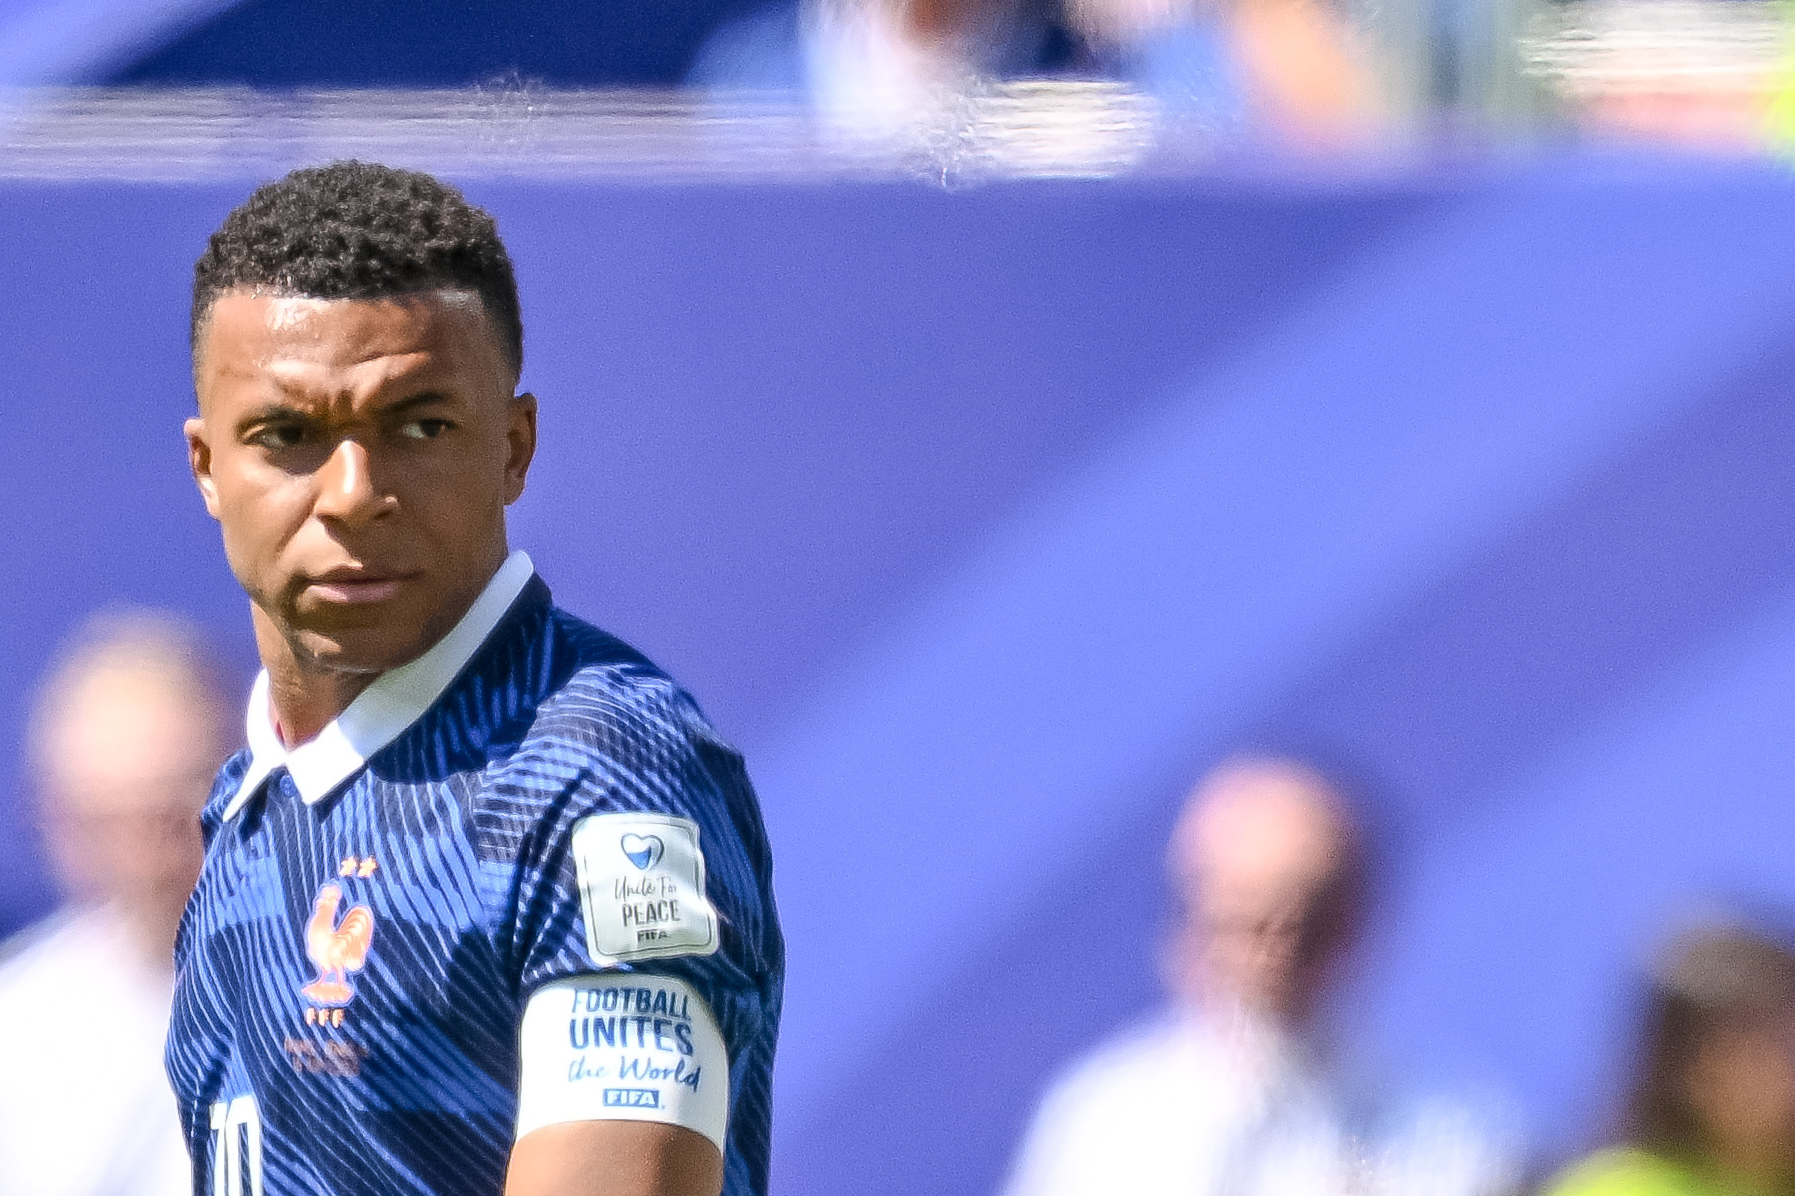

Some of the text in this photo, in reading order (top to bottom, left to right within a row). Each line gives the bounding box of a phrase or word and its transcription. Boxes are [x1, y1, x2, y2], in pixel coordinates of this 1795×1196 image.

[622, 899, 681, 927] PEACE
[572, 987, 691, 1021] FOOTBALL
[569, 1016, 694, 1057] UNITES
[568, 1056, 701, 1093] the World
[605, 1089, 658, 1107] FIFA
